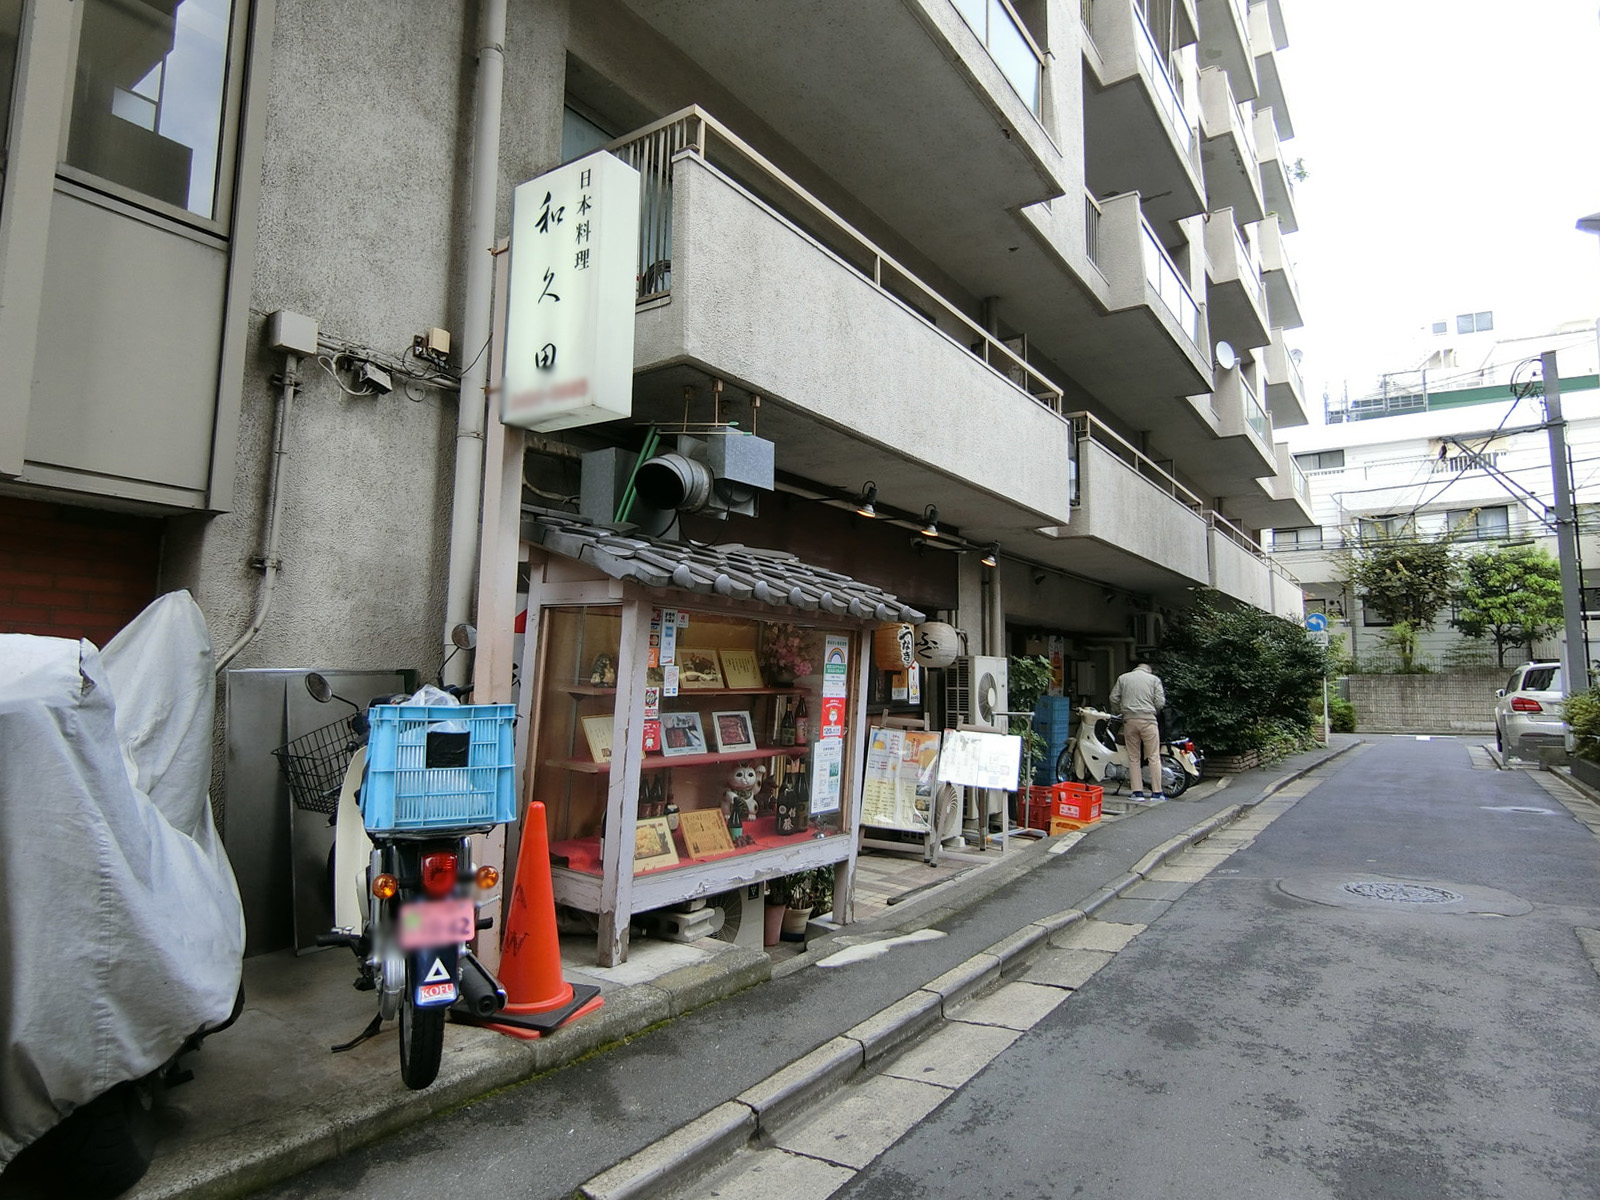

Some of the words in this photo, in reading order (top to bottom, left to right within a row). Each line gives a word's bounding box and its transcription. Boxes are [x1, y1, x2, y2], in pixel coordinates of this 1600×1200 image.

[574, 168, 592, 271] 日本料理
[534, 191, 565, 369] 和久田
[899, 625, 914, 665] うなぎ
[915, 631, 940, 659] ふぐ
[421, 984, 455, 998] KOFU
